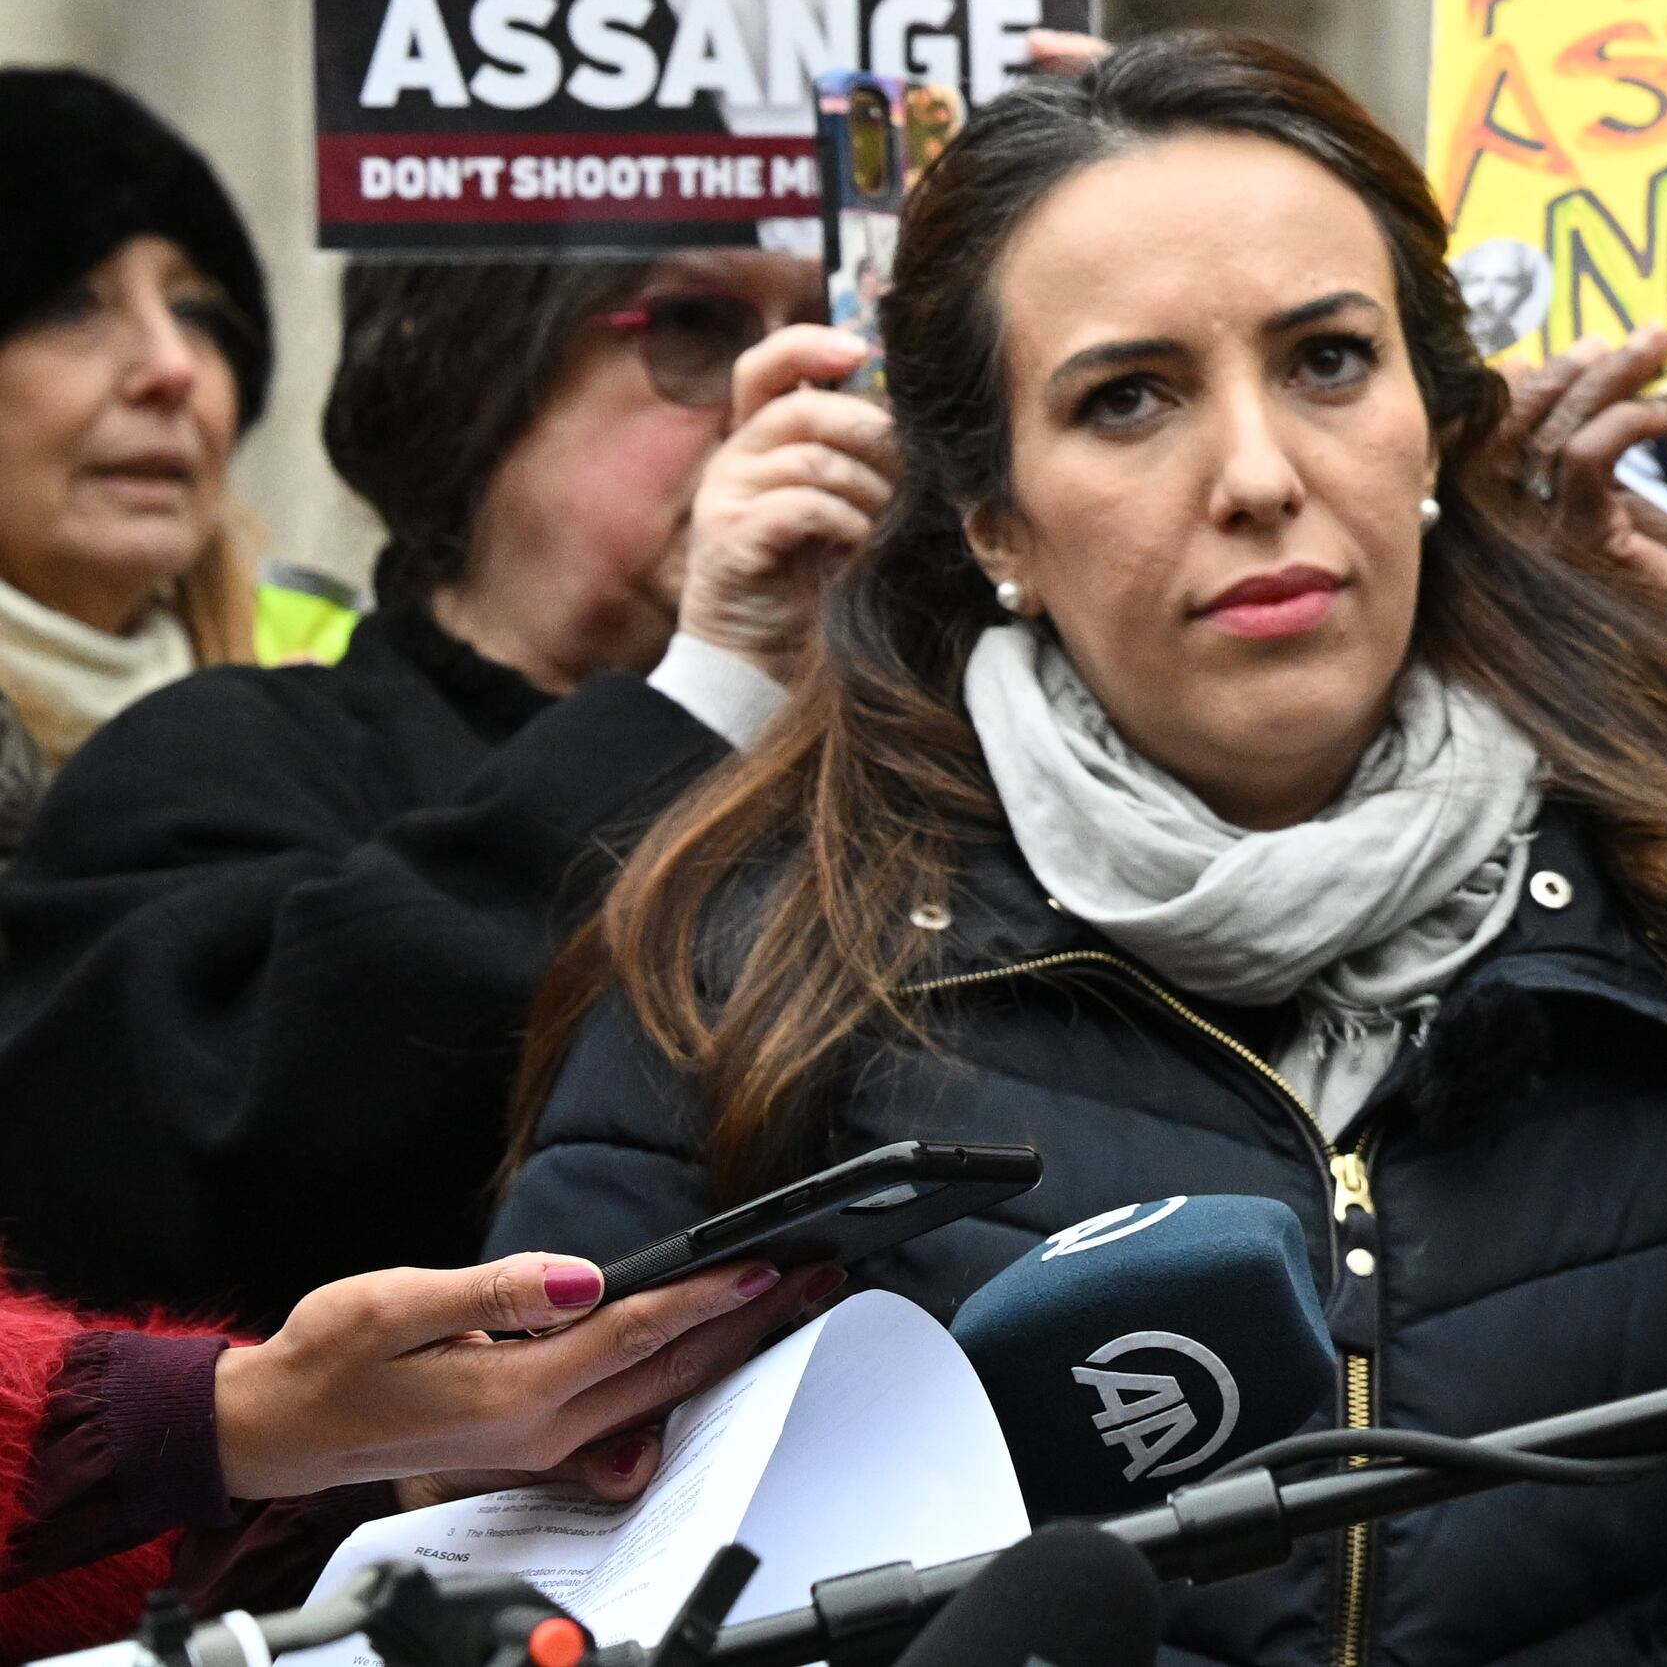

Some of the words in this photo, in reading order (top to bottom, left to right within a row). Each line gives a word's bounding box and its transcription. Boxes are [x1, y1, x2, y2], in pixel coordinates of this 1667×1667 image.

[360, 156, 505, 201] DON'T
[511, 157, 666, 201] SHOOT
[676, 158, 761, 201] THE
[414, 1546, 471, 1563] REASONS
